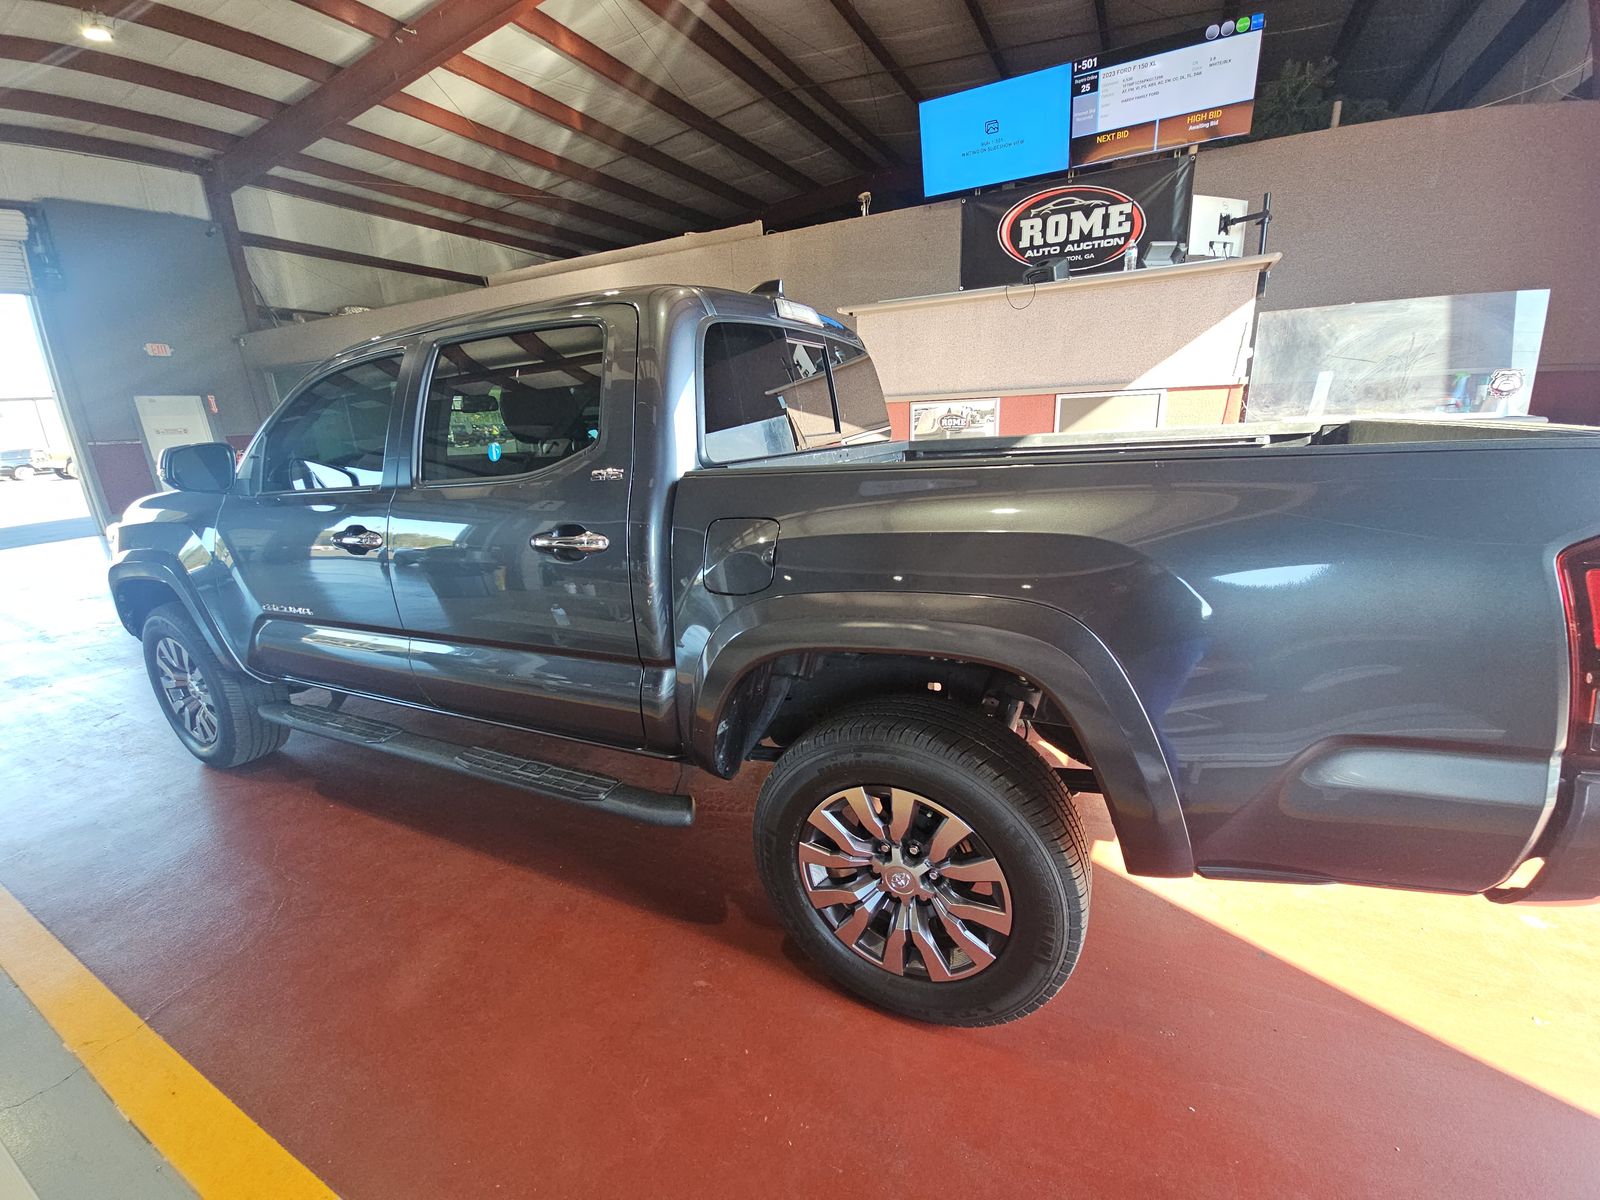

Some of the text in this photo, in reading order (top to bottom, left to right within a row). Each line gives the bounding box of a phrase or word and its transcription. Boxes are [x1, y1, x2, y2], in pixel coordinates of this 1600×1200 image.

[1102, 70, 1116, 79] 2023
[1116, 66, 1132, 76] FORD
[1138, 62, 1149, 70] 150
[1080, 83, 1091, 94] 25
[1187, 109, 1222, 124] HIGH BID
[1210, 119, 1219, 127] Bid
[1096, 130, 1129, 144] NEXT BID
[1019, 202, 1133, 248] ROME
[1024, 236, 1124, 258] AUTO AUCTION
